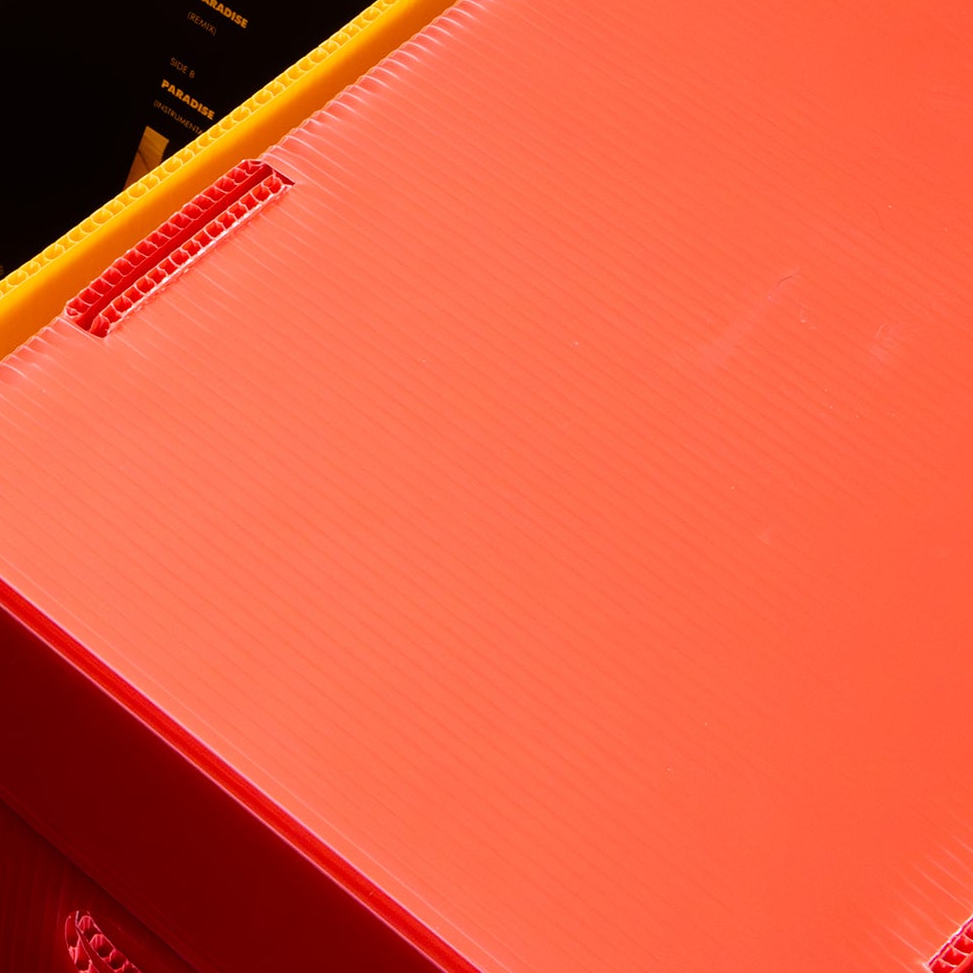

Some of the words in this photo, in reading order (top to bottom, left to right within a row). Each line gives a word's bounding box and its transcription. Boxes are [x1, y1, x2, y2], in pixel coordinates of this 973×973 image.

[187, 11, 217, 36] (REMIX)
[170, 57, 188, 74] SIDE
[161, 79, 215, 120] PARADISE
